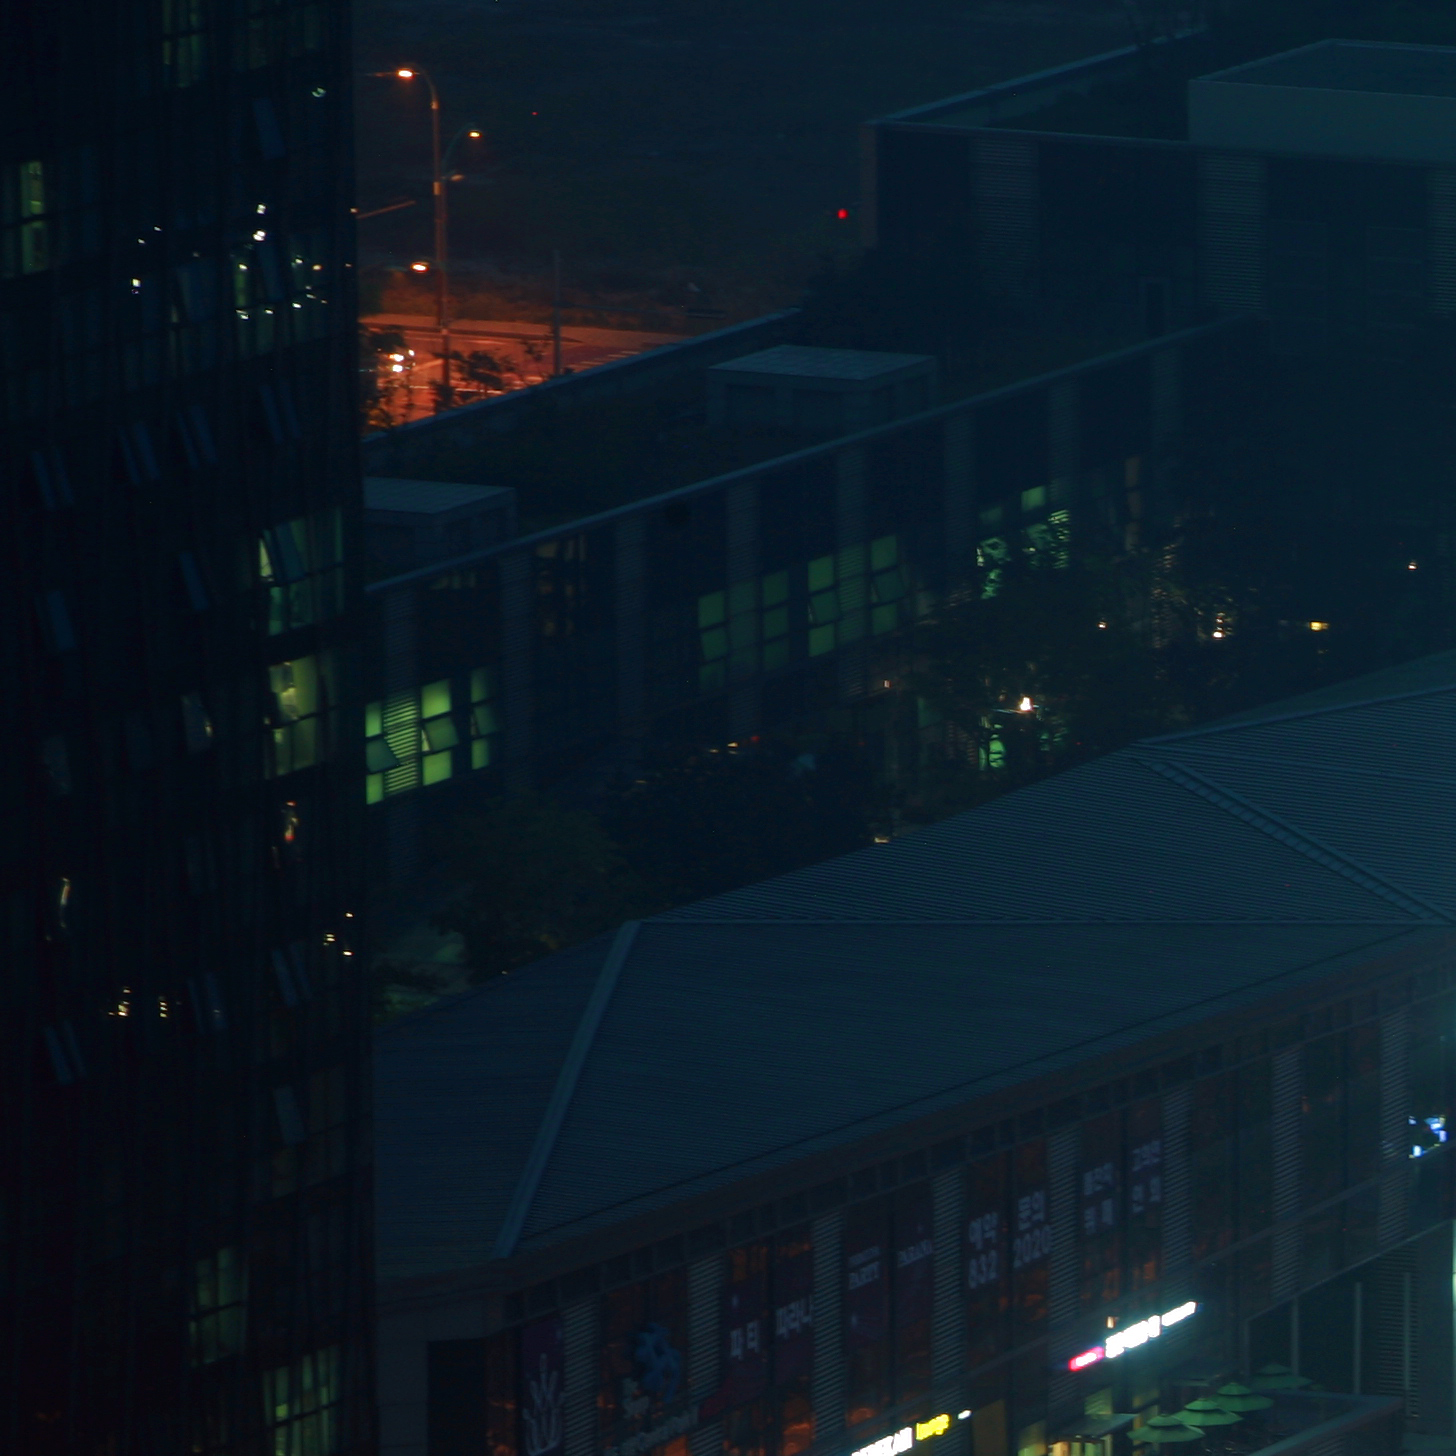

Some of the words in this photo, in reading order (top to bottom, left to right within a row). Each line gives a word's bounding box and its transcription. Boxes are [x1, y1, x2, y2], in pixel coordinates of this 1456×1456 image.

[969, 1211, 998, 1250] 예약
[1018, 1190, 1045, 1231] 문의
[968, 1250, 997, 1289] 832
[1013, 1225, 1053, 1269] 2020
